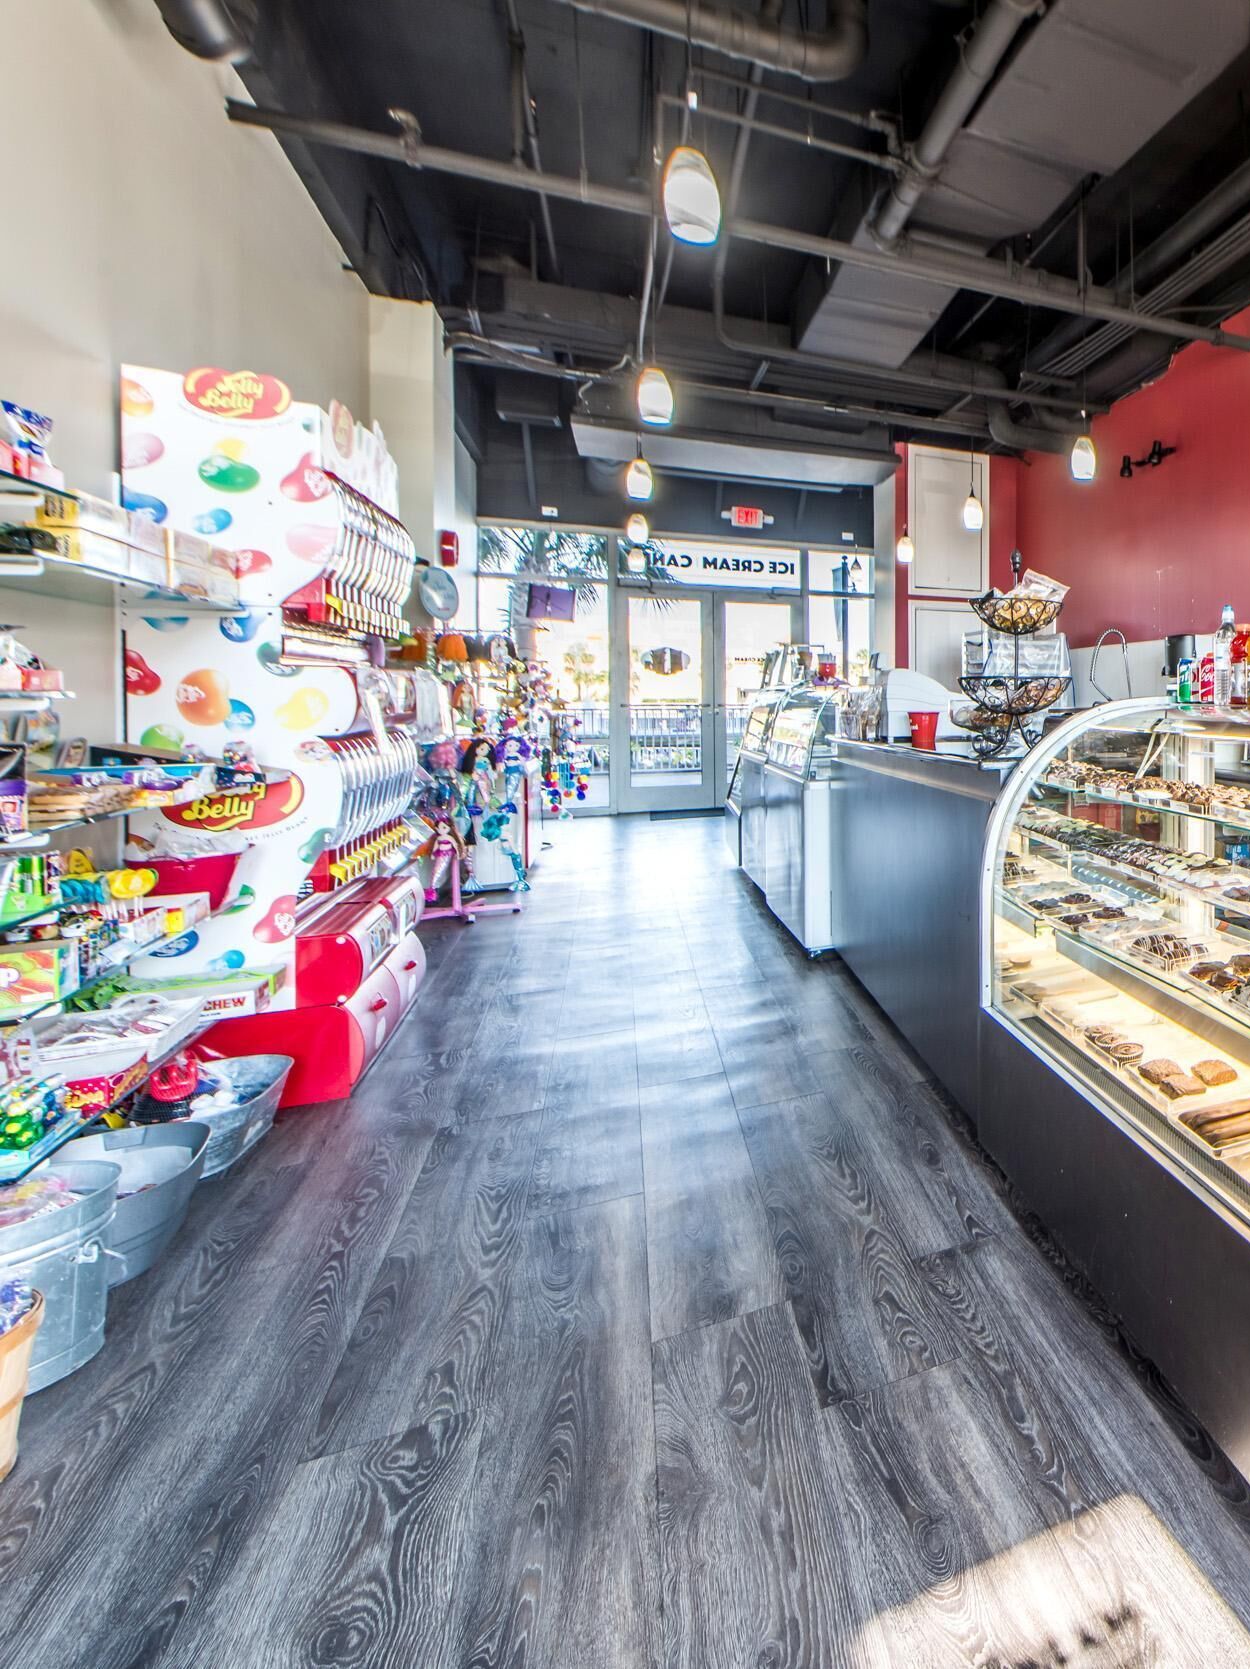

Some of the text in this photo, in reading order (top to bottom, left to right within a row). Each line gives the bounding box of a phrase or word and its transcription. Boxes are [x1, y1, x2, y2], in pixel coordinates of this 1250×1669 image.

[216, 371, 264, 401] Jelly
[198, 388, 255, 417] Belly
[737, 508, 759, 526] EXIT
[181, 795, 255, 832] Belly
